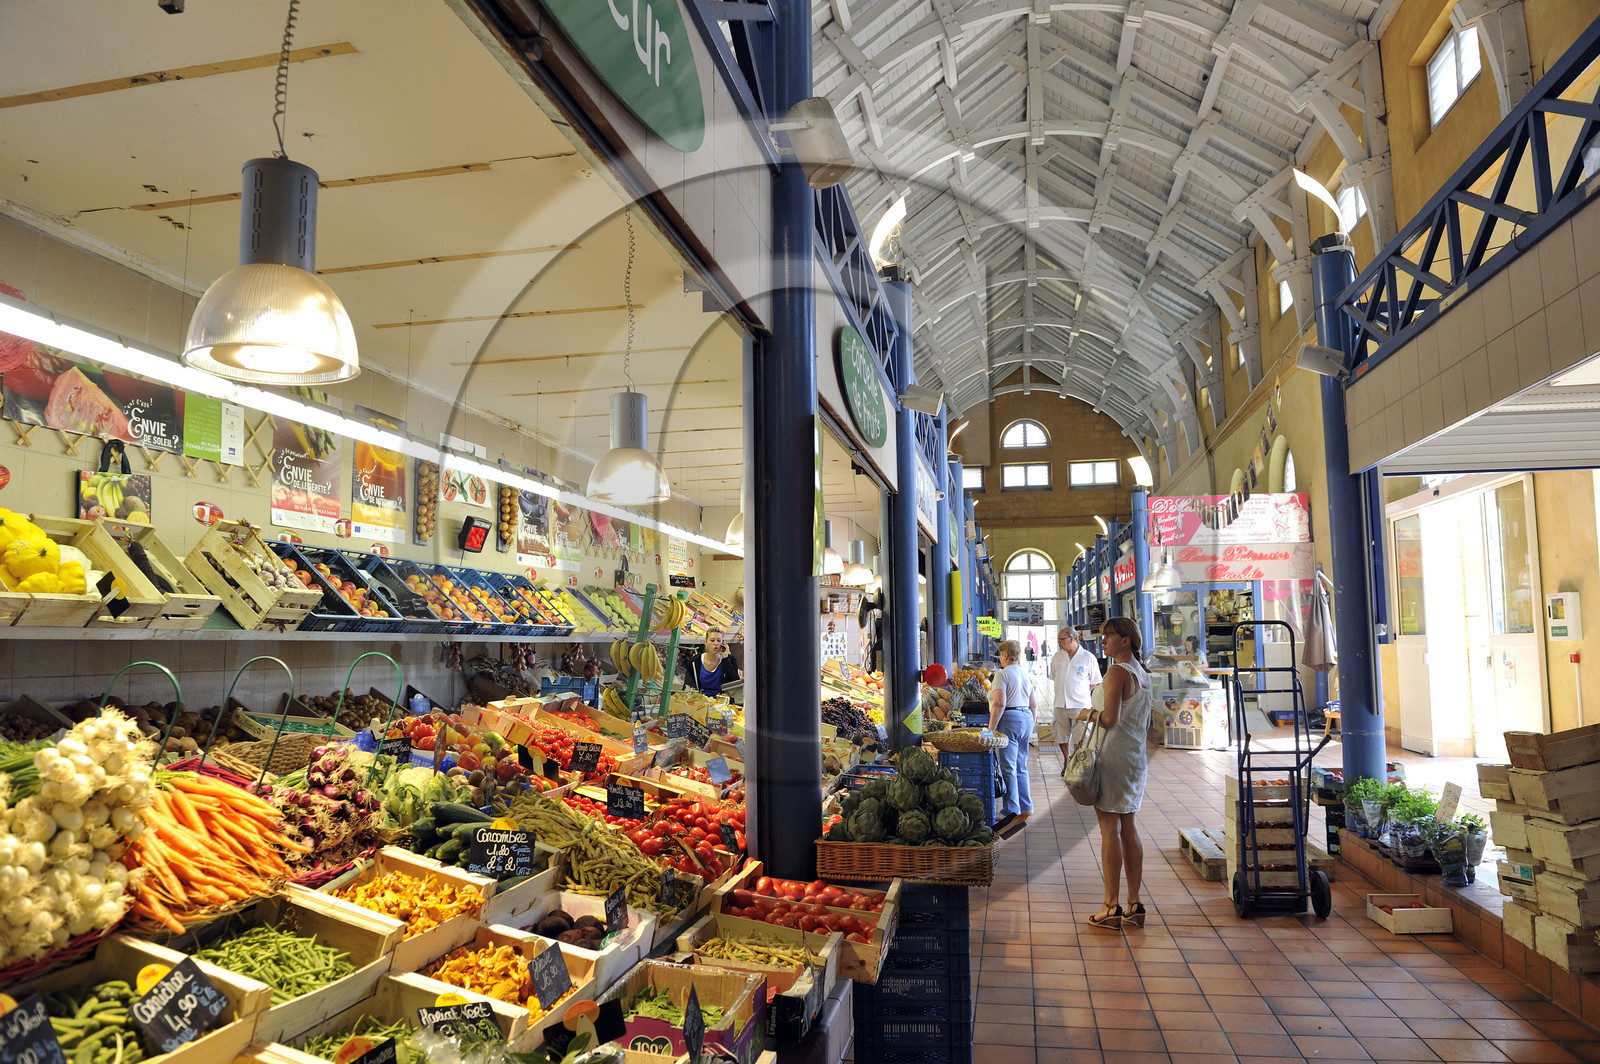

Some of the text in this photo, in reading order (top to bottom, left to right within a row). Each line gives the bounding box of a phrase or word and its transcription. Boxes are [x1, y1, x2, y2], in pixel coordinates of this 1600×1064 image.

[127, 407, 167, 439] ENVIE
[143, 434, 152, 444] DE
[281, 455, 313, 485] ENVIE
[293, 479, 301, 489] DE
[360, 474, 385, 501] ENVIE
[476, 828, 529, 843] Concombre
[163, 993, 198, 1032] 4,90
[769, 1005, 777, 1036] Légumes
